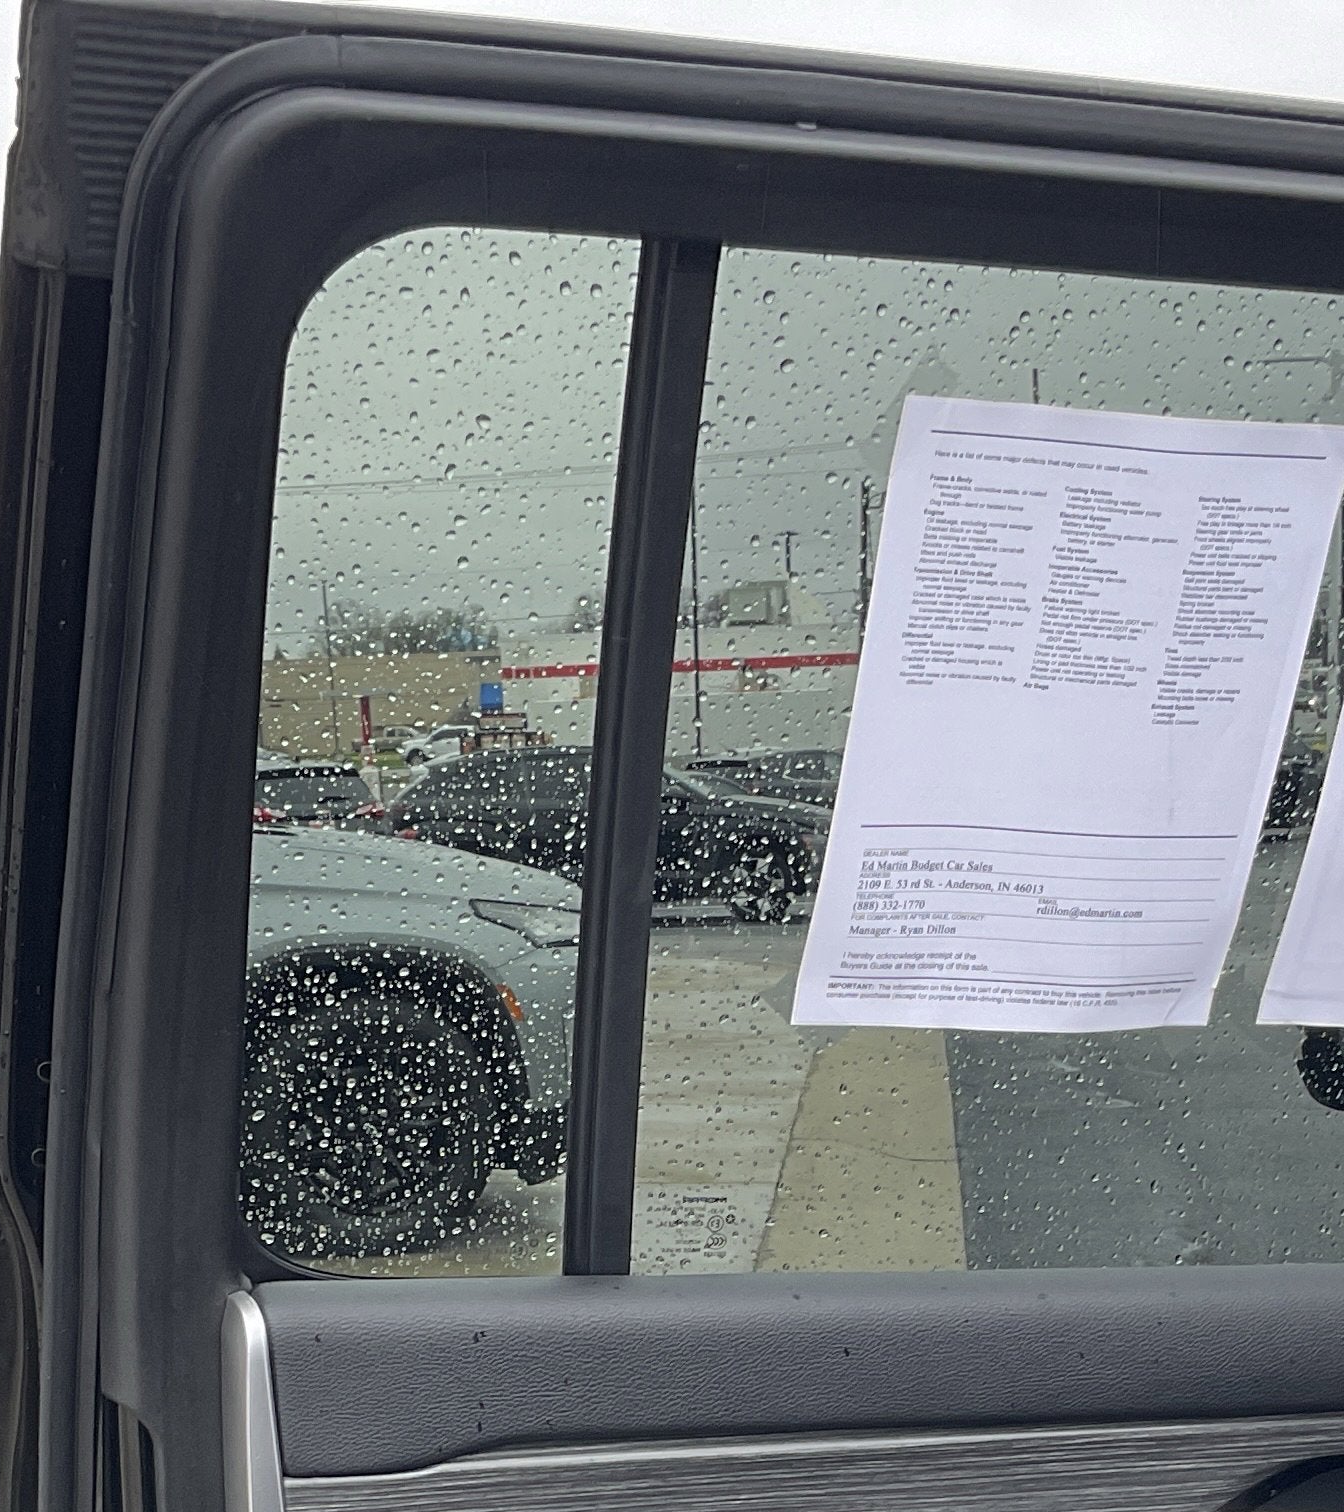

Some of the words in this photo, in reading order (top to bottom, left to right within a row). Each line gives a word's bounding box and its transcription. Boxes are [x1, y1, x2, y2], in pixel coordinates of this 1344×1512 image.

[861, 860, 874, 871] Ed
[877, 860, 908, 871] Martin
[911, 860, 943, 871] Budget
[947, 860, 964, 870] Car
[967, 861, 993, 872] Sales
[857, 880, 881, 889] 2109
[896, 880, 908, 889] 53
[910, 879, 920, 889] rd
[945, 879, 995, 892] Anderson,
[997, 882, 1011, 891] IN
[1013, 883, 1044, 894] 46013
[853, 901, 879, 911] (888)
[881, 900, 925, 910] 332-1770
[1036, 905, 1143, 919] rdillon@edmartin.com
[849, 925, 893, 937] Manager
[900, 925, 923, 936] Ryan
[927, 925, 956, 934] Dillon
[847, 952, 874, 960] hereby
[876, 952, 925, 960] acknowledge
[964, 952, 976, 960] the
[918, 962, 943, 971] closing
[956, 962, 969, 970] this
